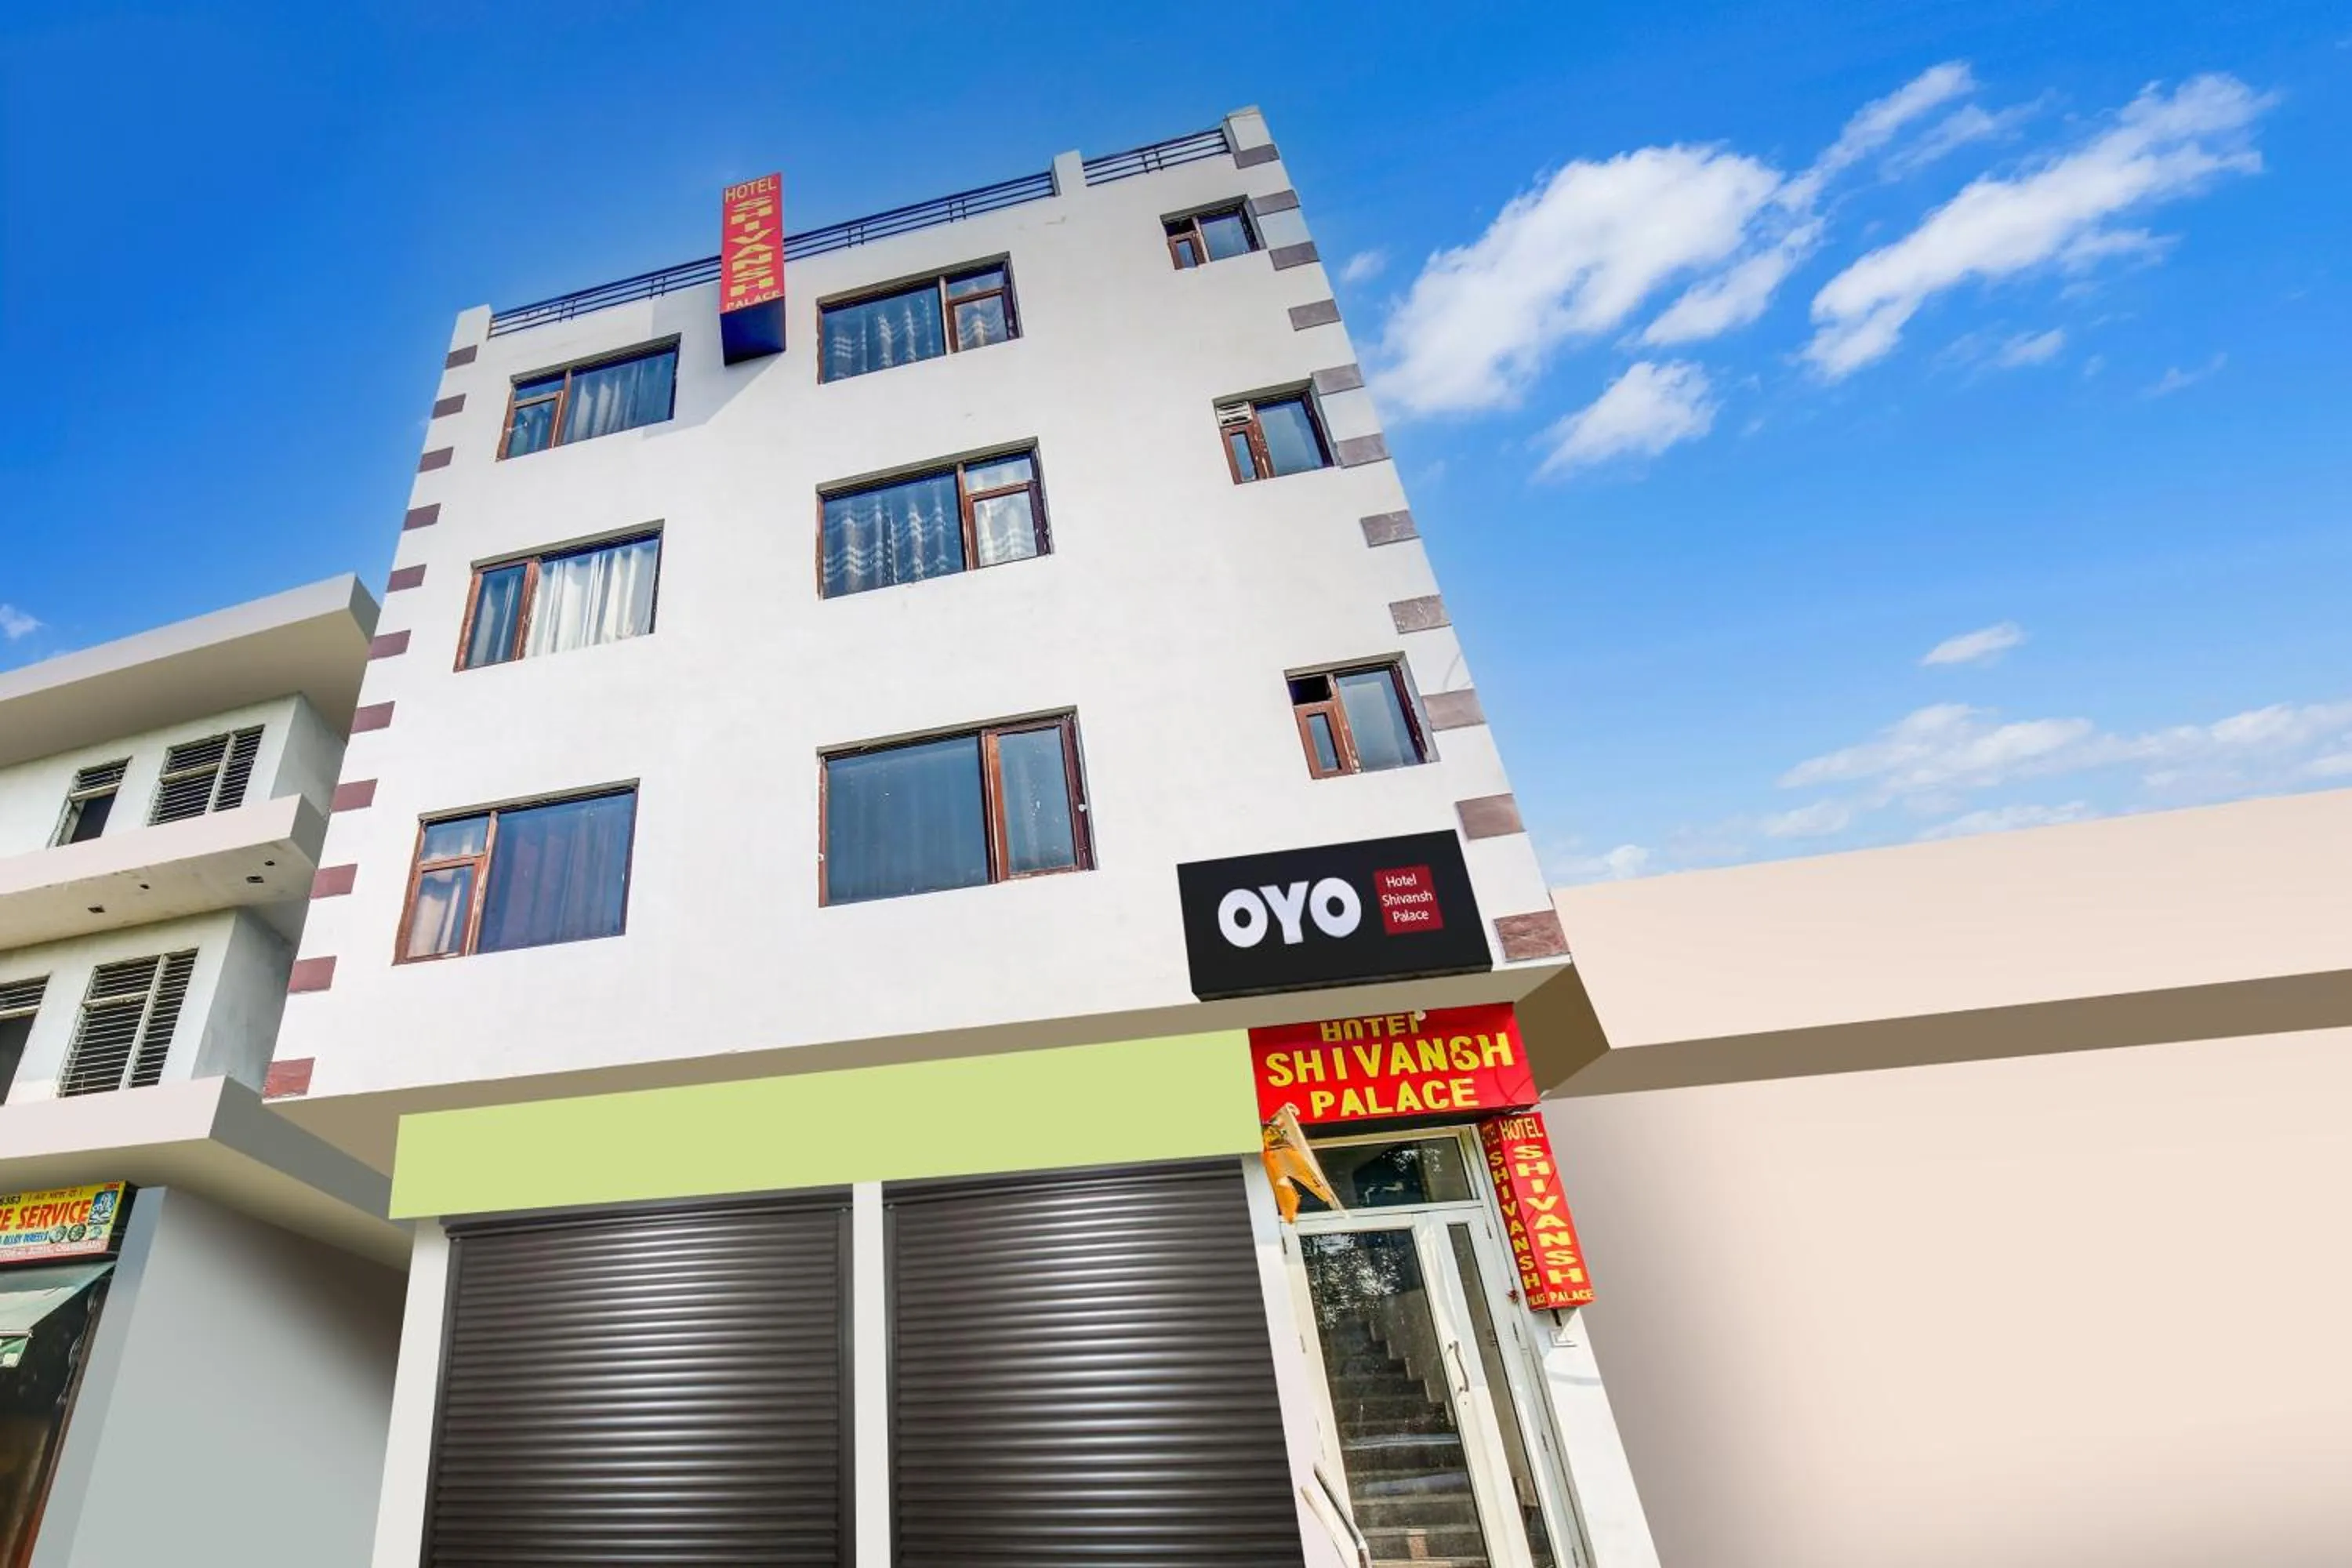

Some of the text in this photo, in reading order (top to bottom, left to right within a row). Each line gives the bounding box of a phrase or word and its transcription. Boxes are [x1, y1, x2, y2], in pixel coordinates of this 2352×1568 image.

[725, 178, 777, 203] HOTEL
[728, 197, 775, 296] SHIVANSH
[1385, 873, 1417, 887] Hotel
[1218, 877, 1362, 947] OYO
[1381, 891, 1433, 907] Shivansh
[1392, 909, 1429, 922] Palace
[1265, 1032, 1515, 1087] SHIVANSH
[1309, 1078, 1479, 1118] PALACE
[1498, 1117, 1544, 1142] HOTEL
[16, 1200, 92, 1229] SERVICE
[1489, 1152, 1541, 1289] SHIVANSH
[1513, 1145, 1584, 1284] SHIVANSH
[1548, 1289, 1594, 1303] PALACE
